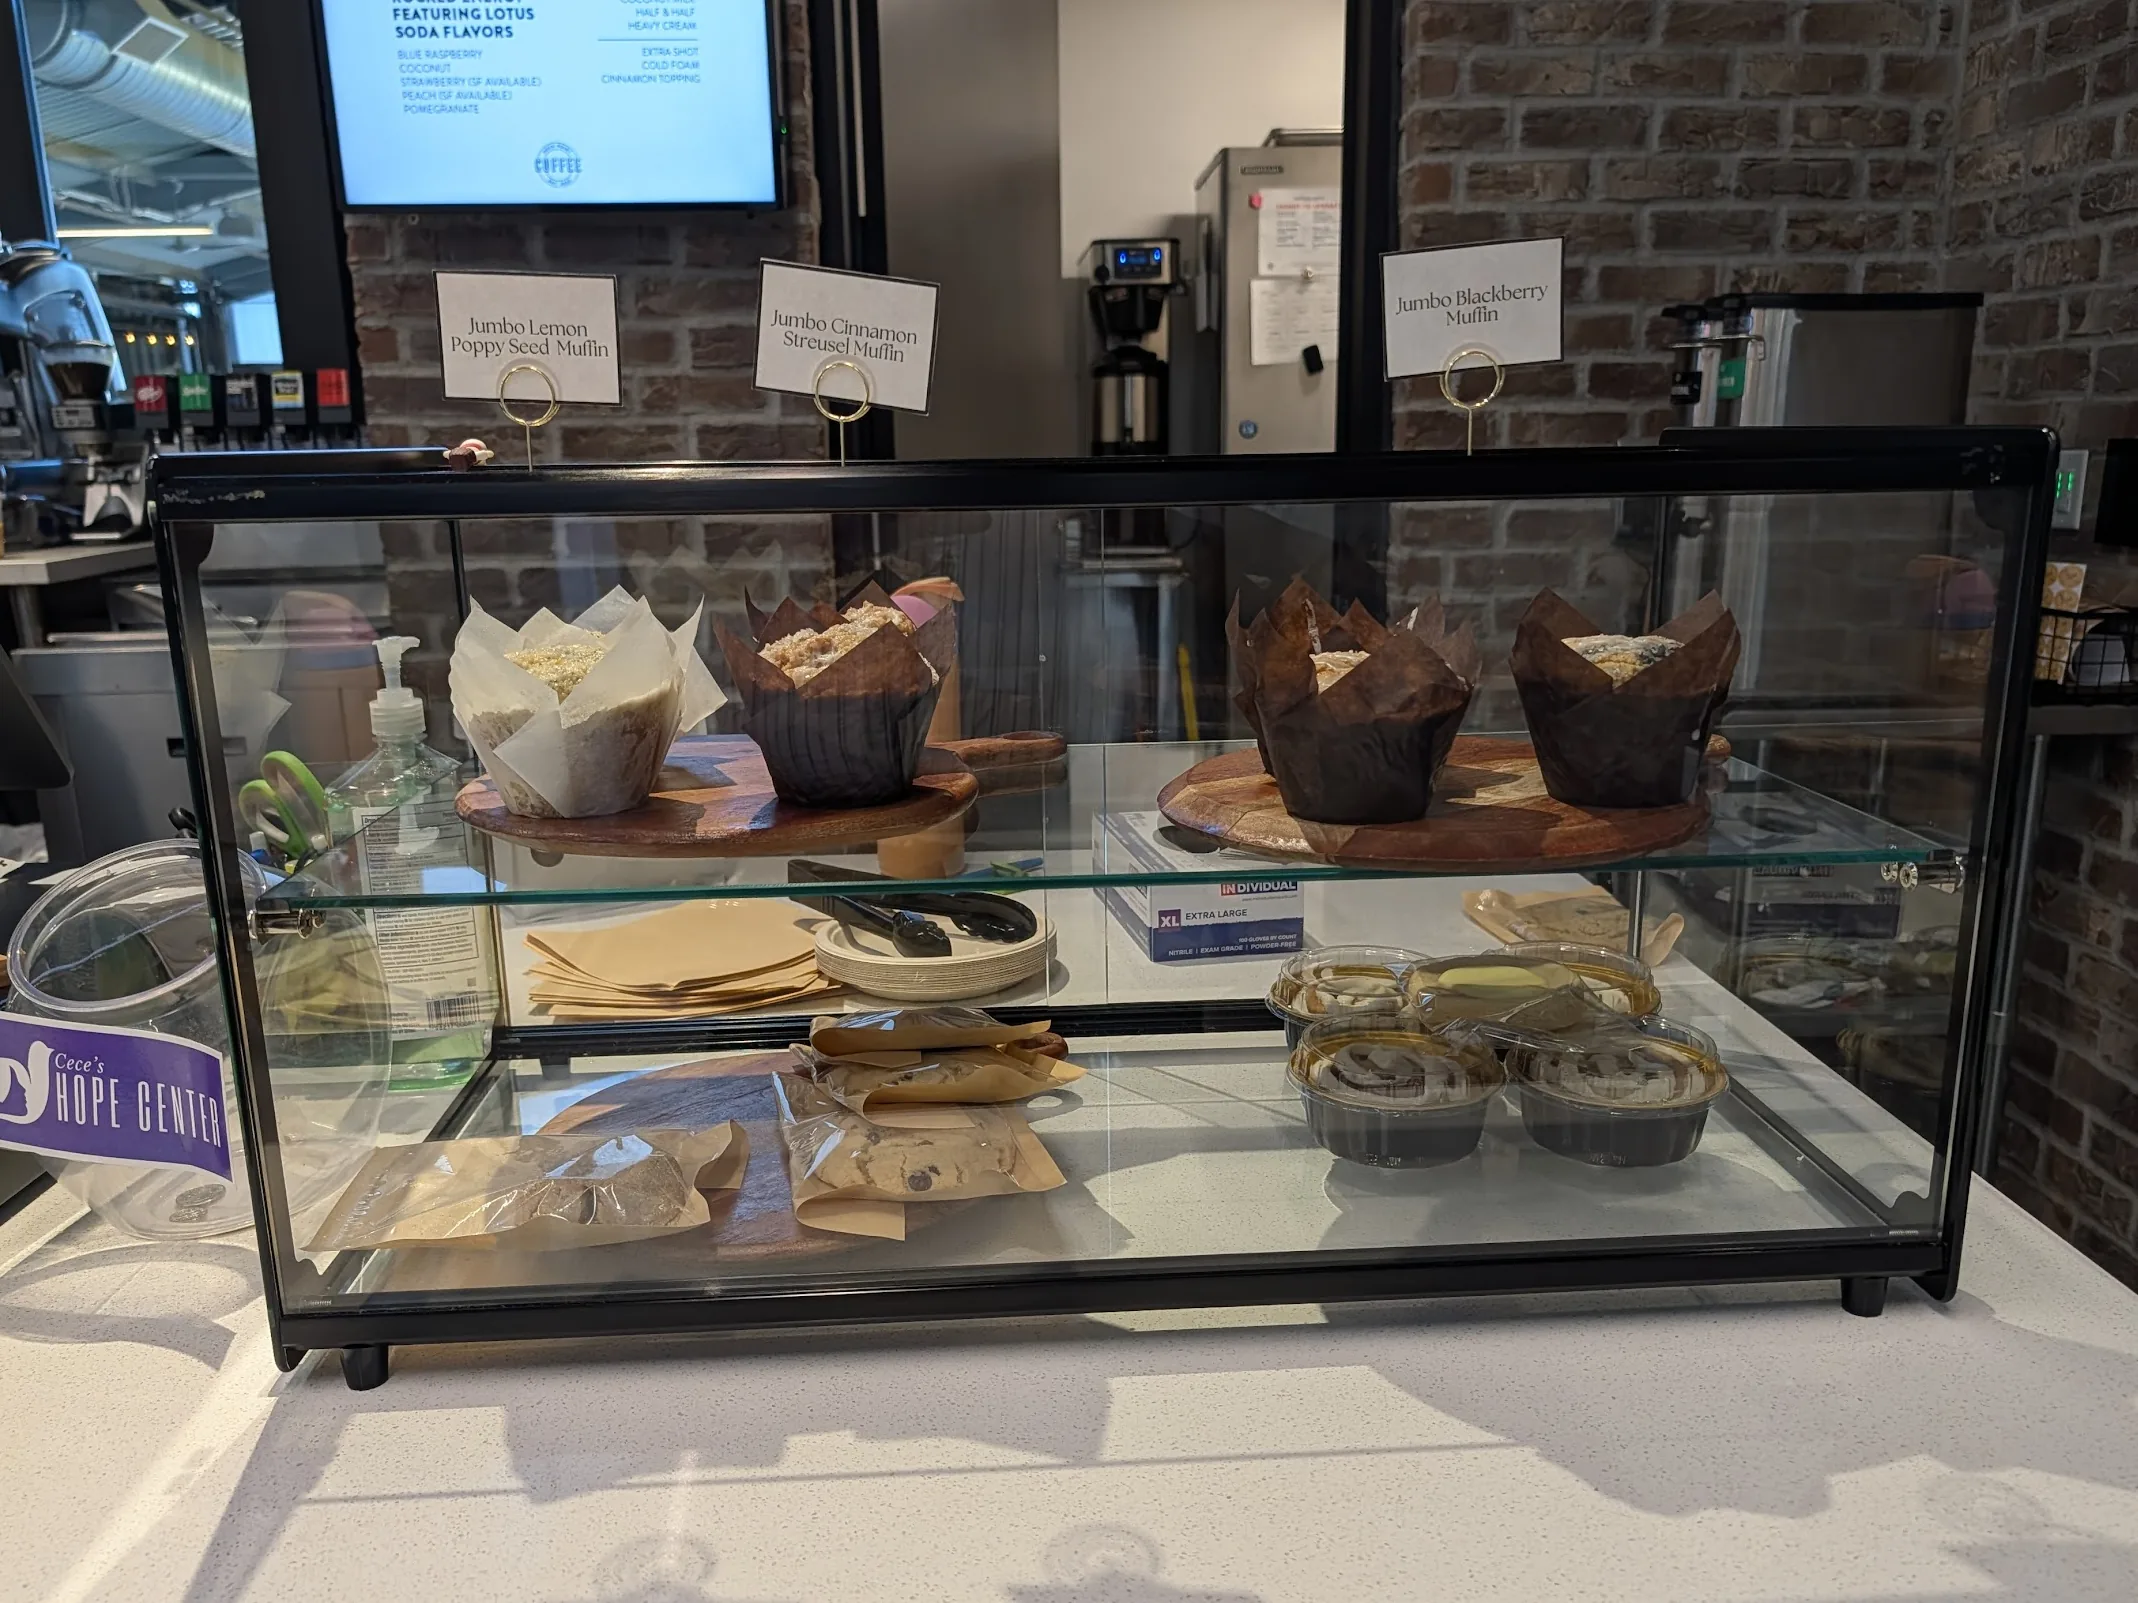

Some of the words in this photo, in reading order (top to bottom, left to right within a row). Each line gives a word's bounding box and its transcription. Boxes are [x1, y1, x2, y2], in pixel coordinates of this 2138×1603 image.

[393, 8, 481, 20] FEATURING
[486, 8, 535, 20] LOTUS
[395, 26, 439, 38] SODA
[443, 26, 514, 38] FLAVORS
[628, 21, 660, 30] HEAVY
[662, 21, 698, 30] CREAM
[397, 50, 422, 60] BLUE
[425, 50, 483, 60] RASPBERRY
[642, 47, 671, 57] EXTRA
[672, 47, 699, 57] SHOT
[399, 63, 451, 73] COCONUT
[641, 60, 669, 70] COLD
[671, 60, 700, 70] FOAM
[400, 77, 466, 87] STRAWBERRY
[402, 90, 437, 100] PEACH
[403, 103, 480, 114] POMEGRANATE
[535, 158, 582, 173] COFFEE
[1396, 291, 1453, 315] Jumbo
[1456, 284, 1549, 307] Blackberry
[1446, 306, 1499, 326] Muffin
[468, 317, 526, 335] Jumbo
[529, 319, 588, 337] Lemon
[771, 309, 828, 332] Jumbo
[831, 317, 918, 345] Cinnamon
[451, 336, 505, 357] Poppy
[508, 338, 549, 355] Seed
[557, 340, 609, 357] Muffin
[783, 330, 850, 355] Streusel
[853, 340, 905, 363] Muffin
[1221, 880, 1297, 894] INDIVIDUAL
[1185, 911, 1215, 921] EXTRA
[1218, 908, 1248, 918] LARGE
[1160, 915, 1180, 928] XL
[1168, 948, 1193, 956] NITRILE
[1200, 946, 1220, 954] EXAM
[1220, 944, 1243, 952] GRADE
[1251, 941, 1297, 950] POWDER-FREE
[55, 1052, 105, 1074] Cece's
[56, 1071, 121, 1129] HOPE
[137, 1080, 222, 1149] CENTER
